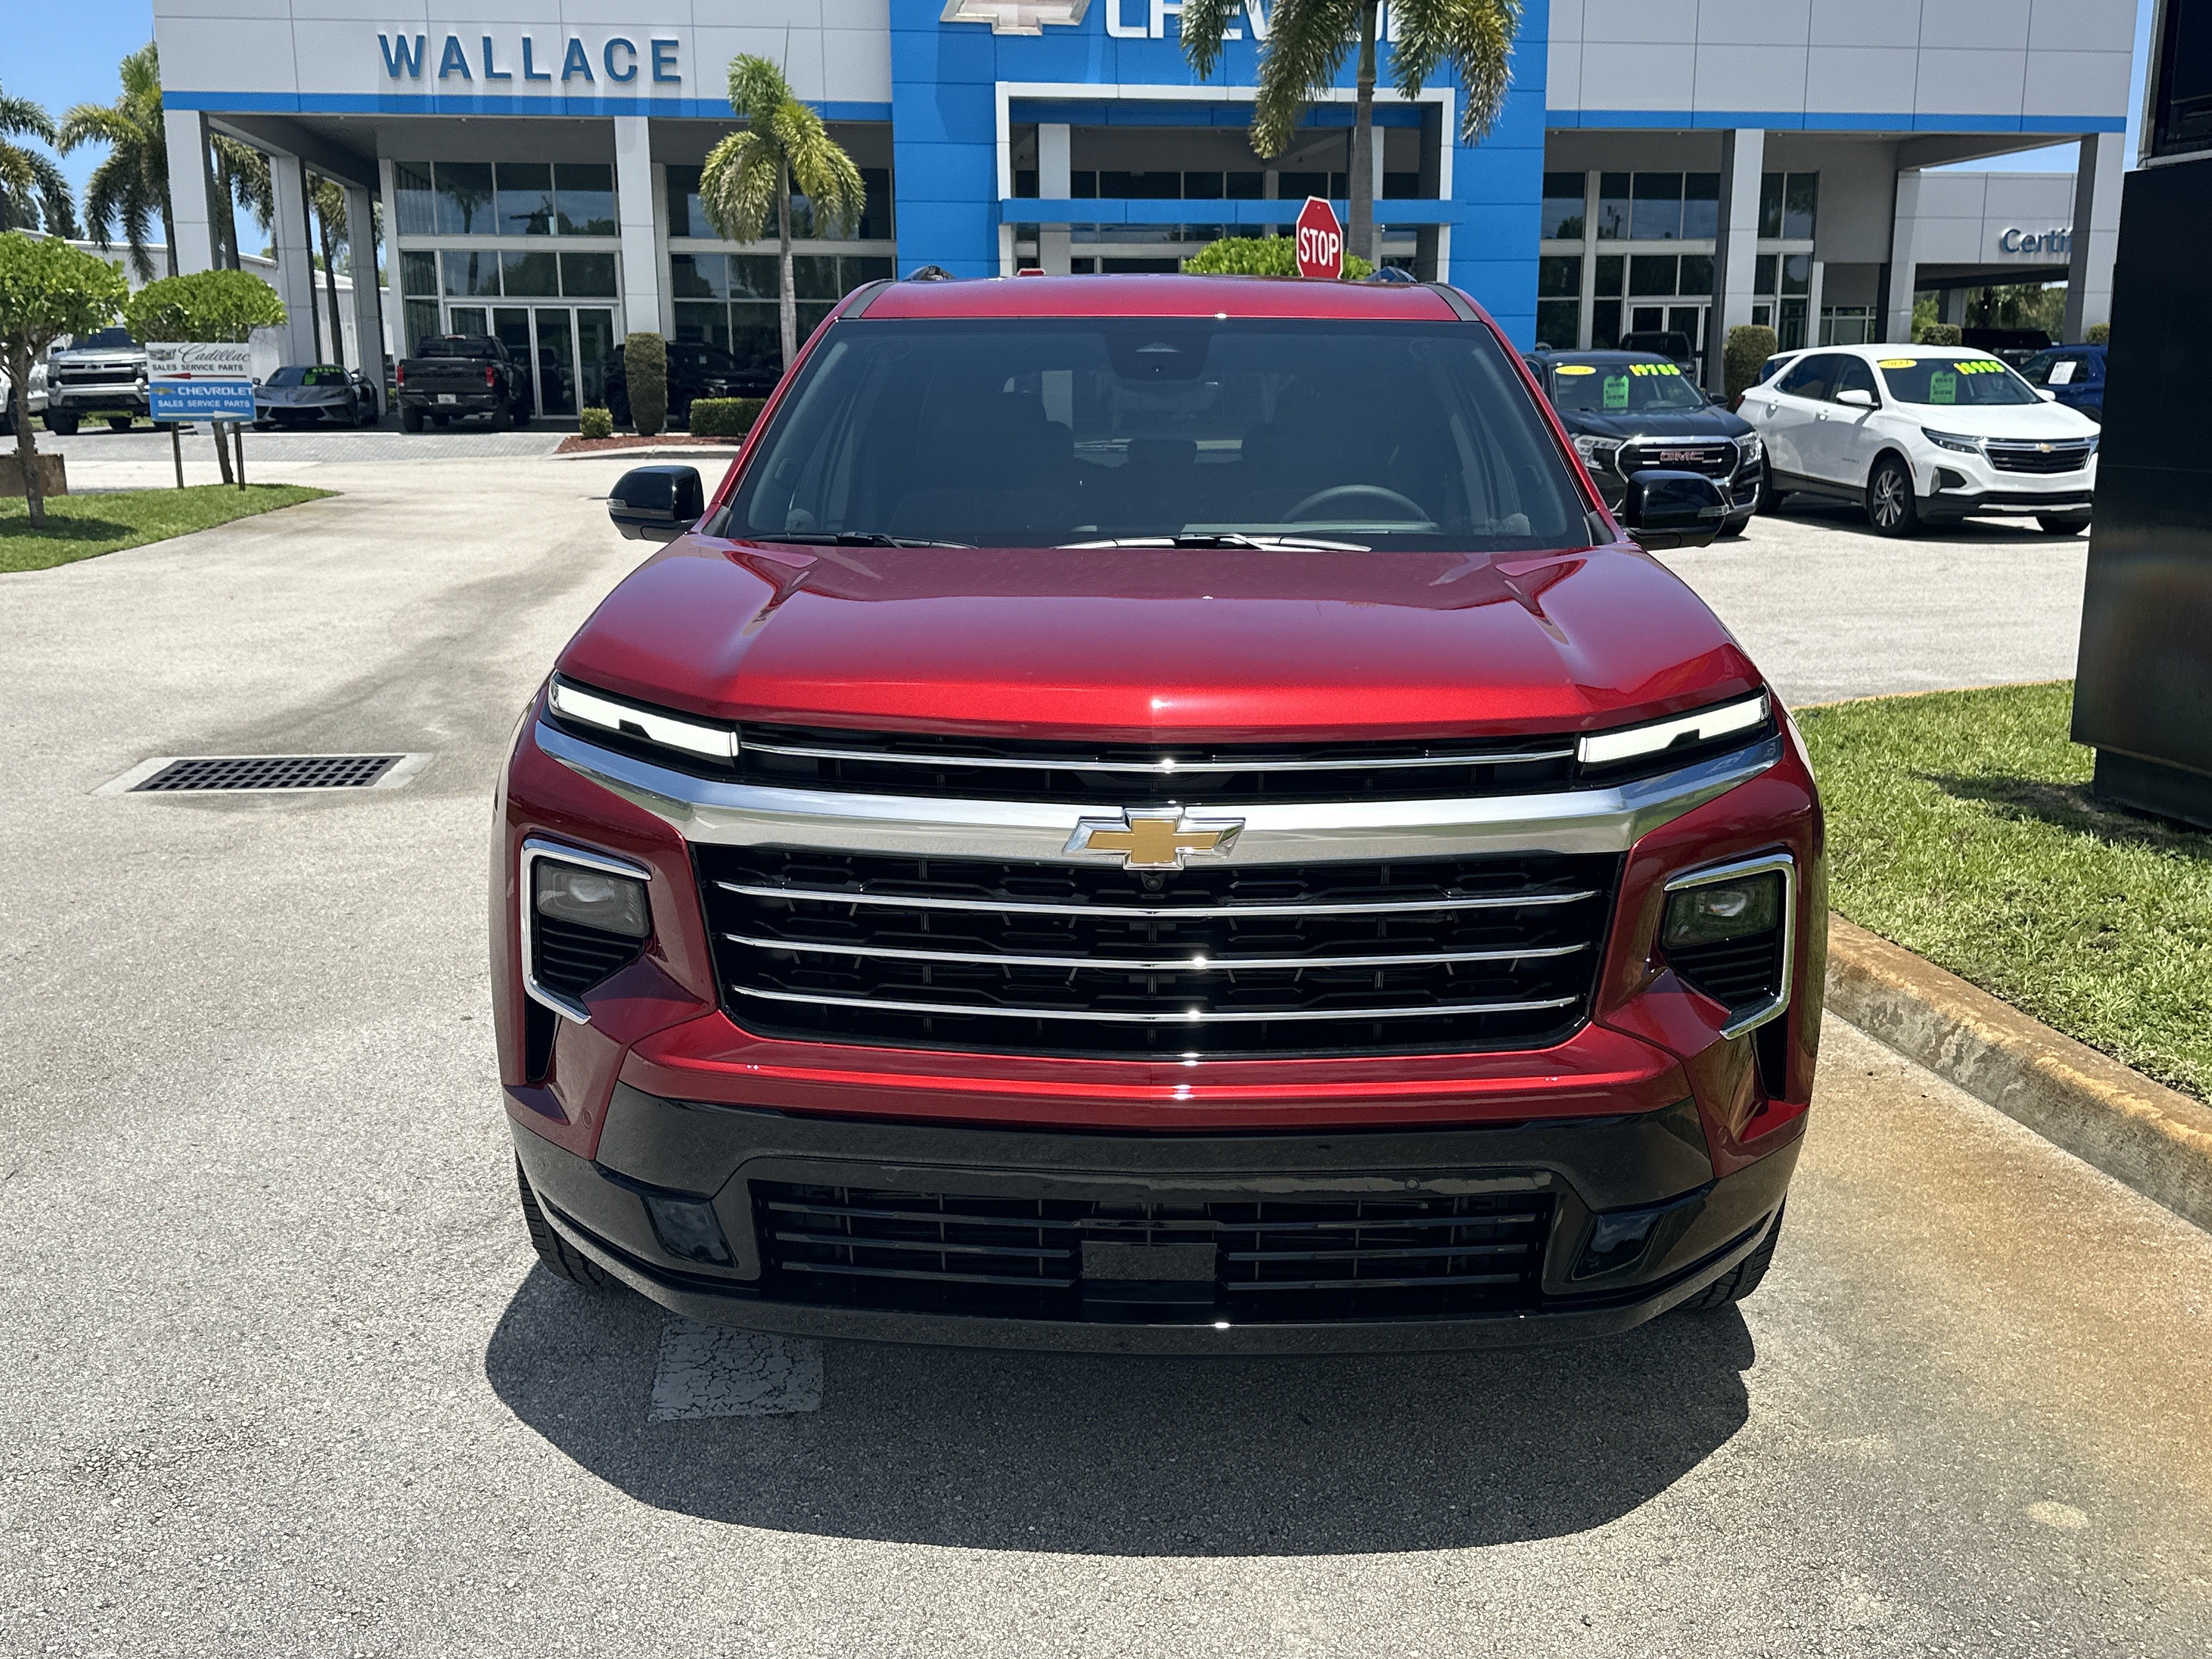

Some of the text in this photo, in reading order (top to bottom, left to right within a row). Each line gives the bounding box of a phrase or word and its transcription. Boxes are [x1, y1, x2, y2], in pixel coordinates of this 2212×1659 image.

[377, 33, 682, 83] WALLACE
[1300, 226, 1339, 267] STOP
[178, 343, 250, 364] Cadillac
[1629, 364, 1680, 376] 19785
[177, 386, 253, 396] CHEVROLET
[157, 399, 250, 408] SALES SERVICE PARTS
[1660, 450, 1704, 461] GMC
